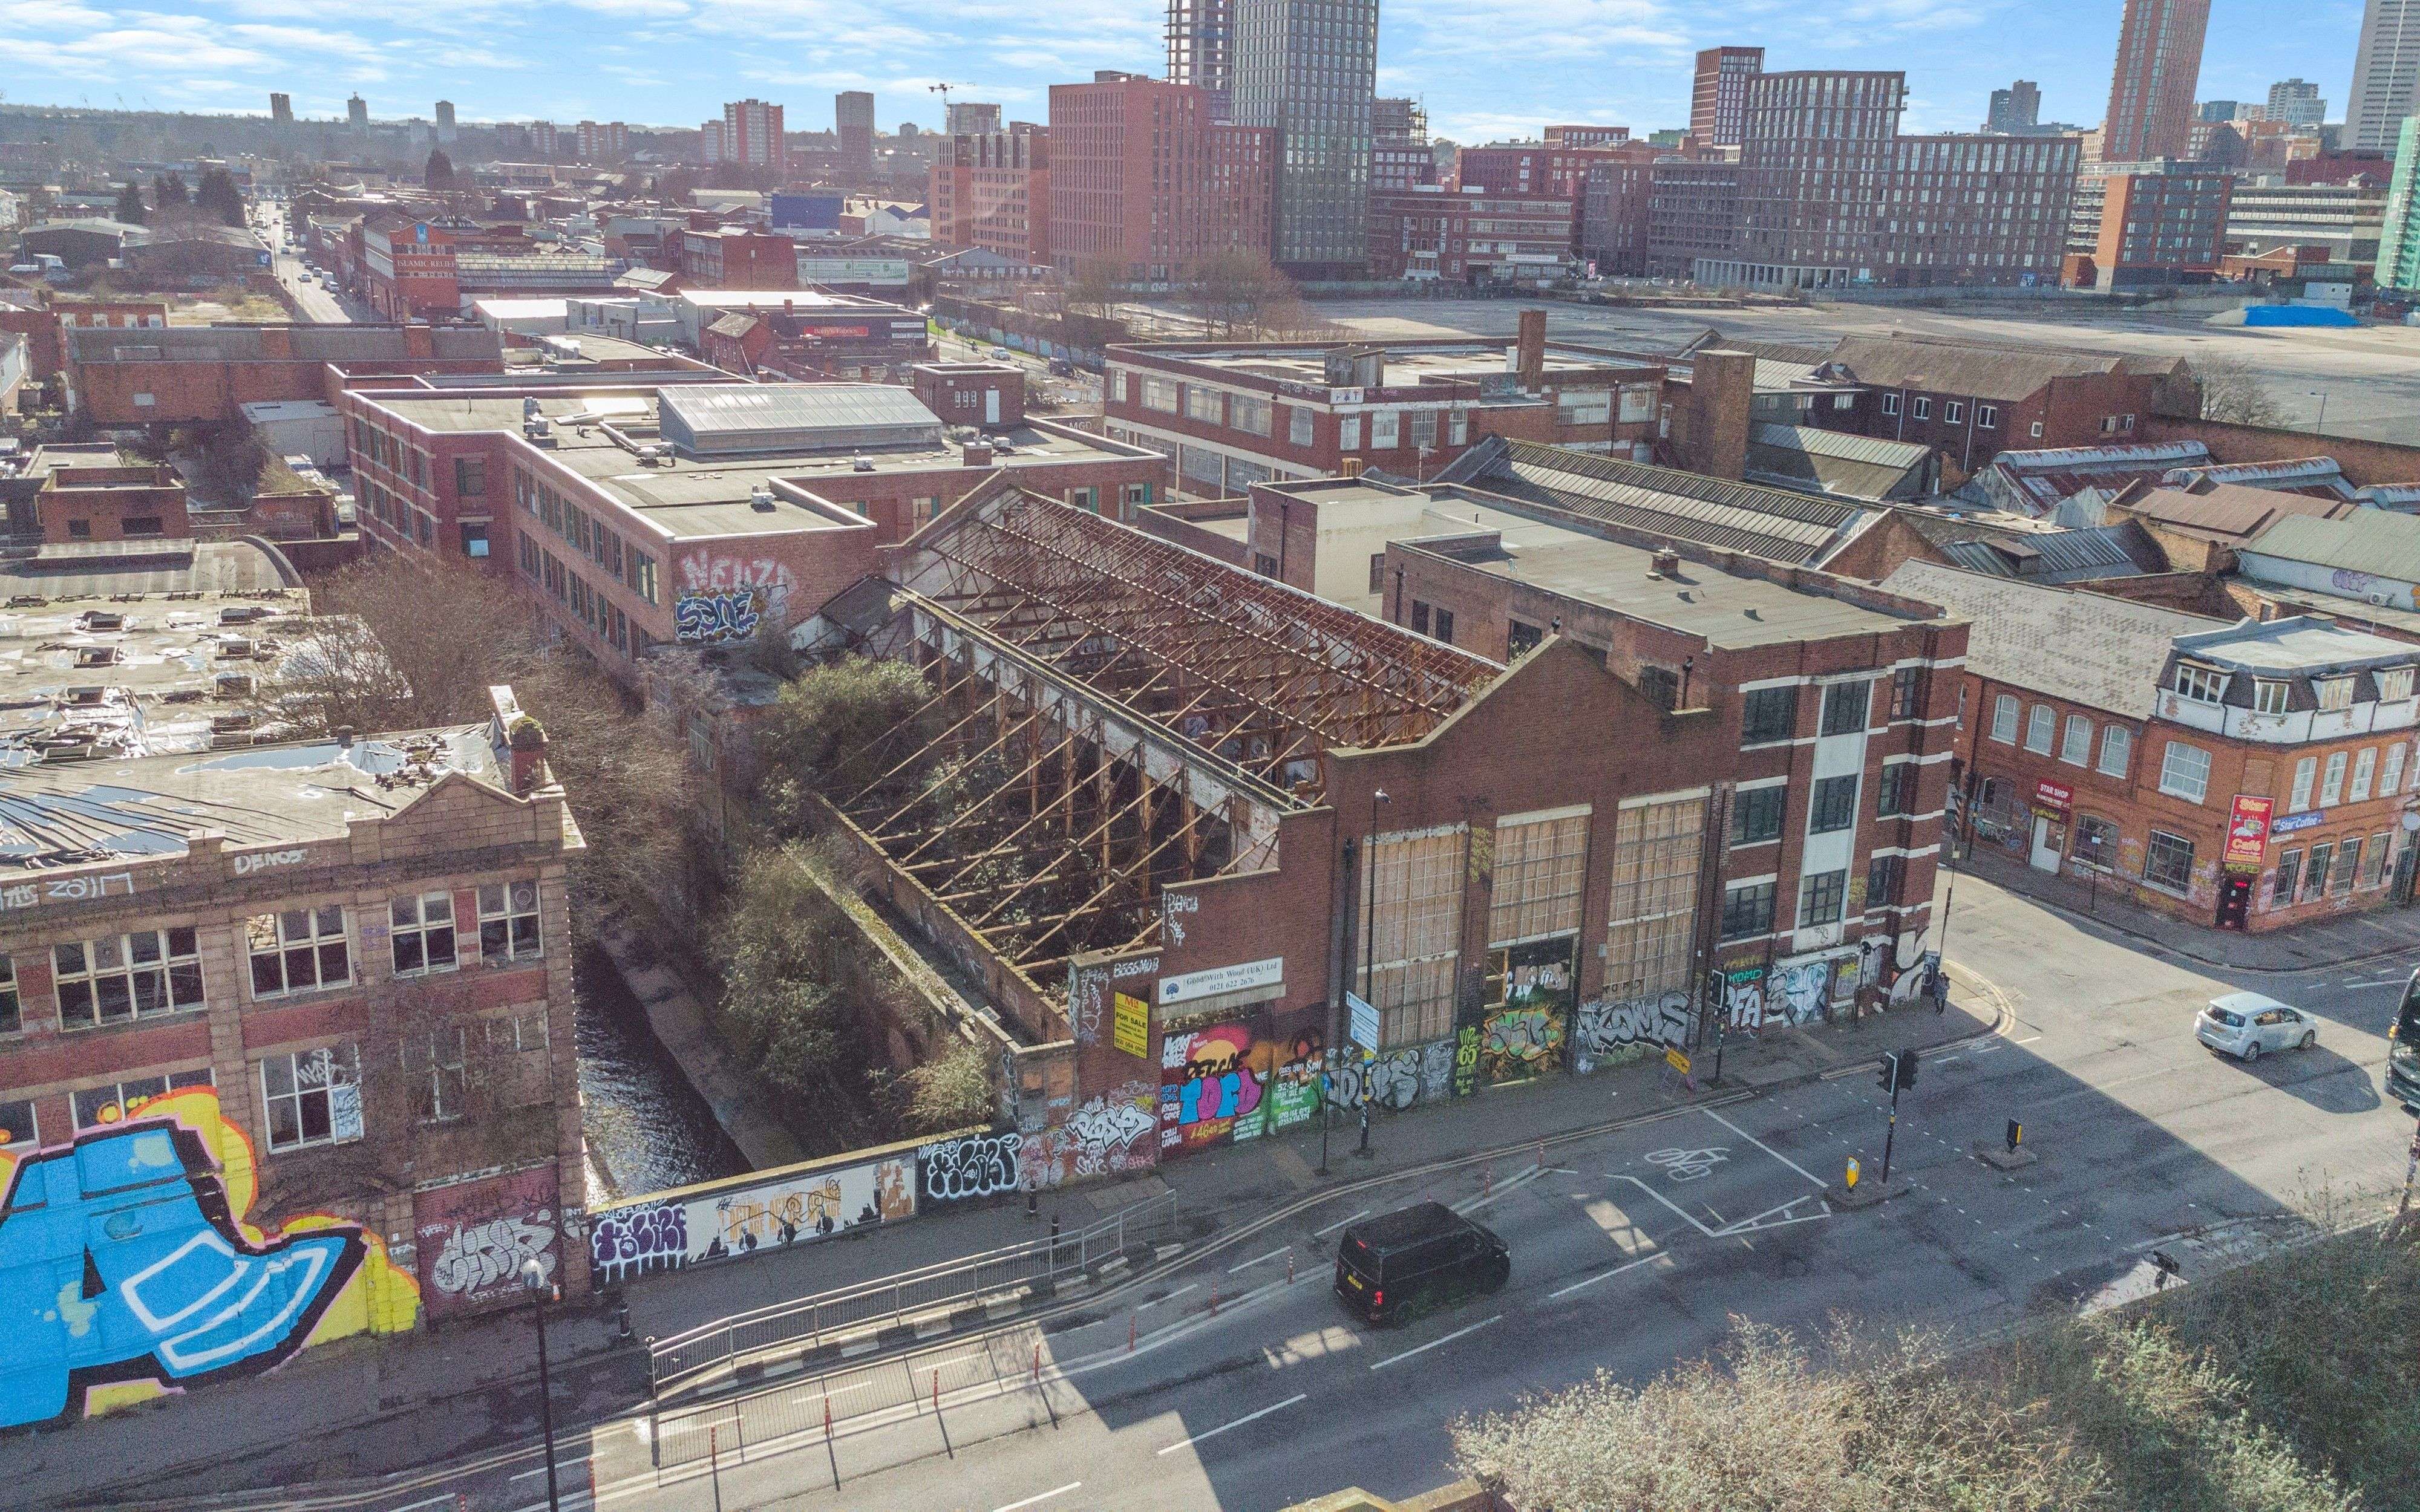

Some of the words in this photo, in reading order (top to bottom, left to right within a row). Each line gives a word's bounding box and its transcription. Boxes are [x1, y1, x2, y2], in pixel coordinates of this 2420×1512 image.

[2040, 784, 2054, 795] STAR
[2054, 788, 2068, 798] SHOP
[2295, 816, 2318, 829] Coffee
[1186, 976, 1204, 987] Good
[1205, 971, 1223, 981] With
[1226, 968, 1245, 977] Wood
[1247, 965, 1263, 976] (UK)
[1267, 962, 1277, 971] Ltd
[1209, 983, 1223, 992] 0121
[1116, 1012, 1128, 1023] FOR
[1131, 1017, 1146, 1028] SALE
